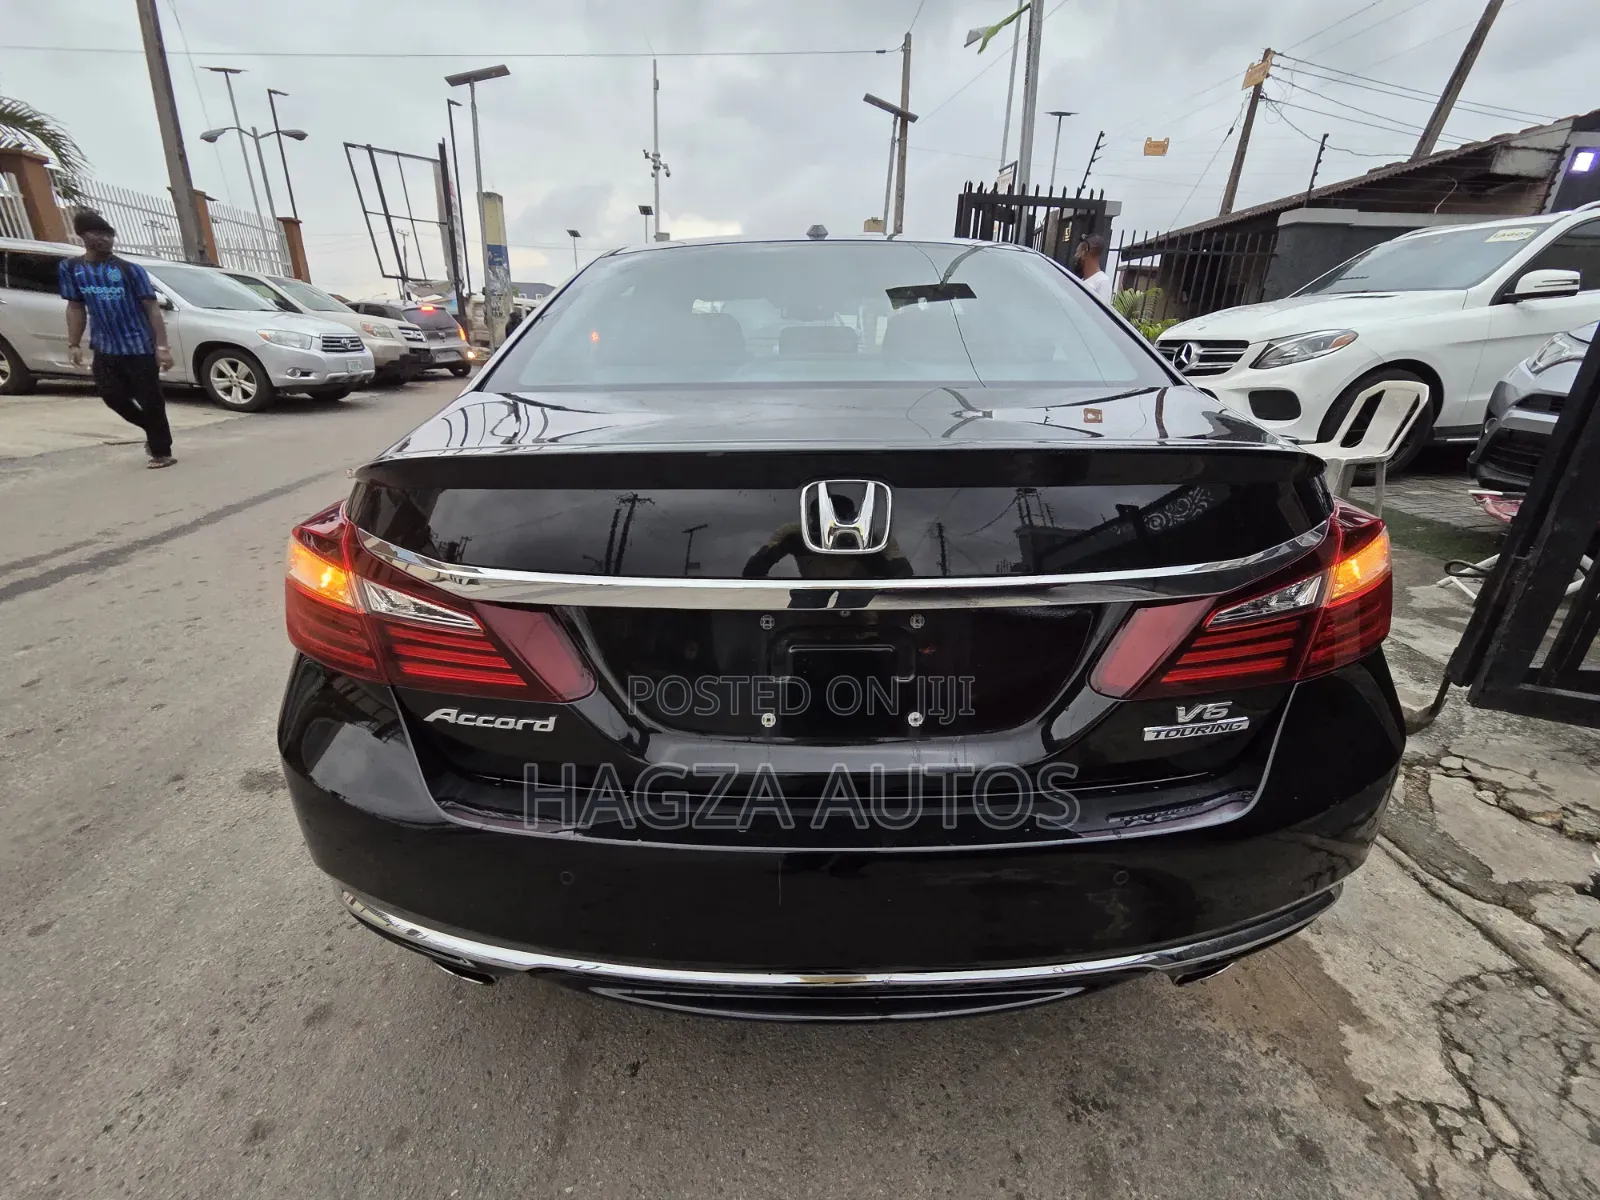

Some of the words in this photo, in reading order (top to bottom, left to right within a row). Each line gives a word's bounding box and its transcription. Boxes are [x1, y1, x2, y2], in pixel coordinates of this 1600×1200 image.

[423, 707, 558, 732] Accord
[1176, 701, 1233, 723] V6
[1152, 721, 1242, 739] TOURING
